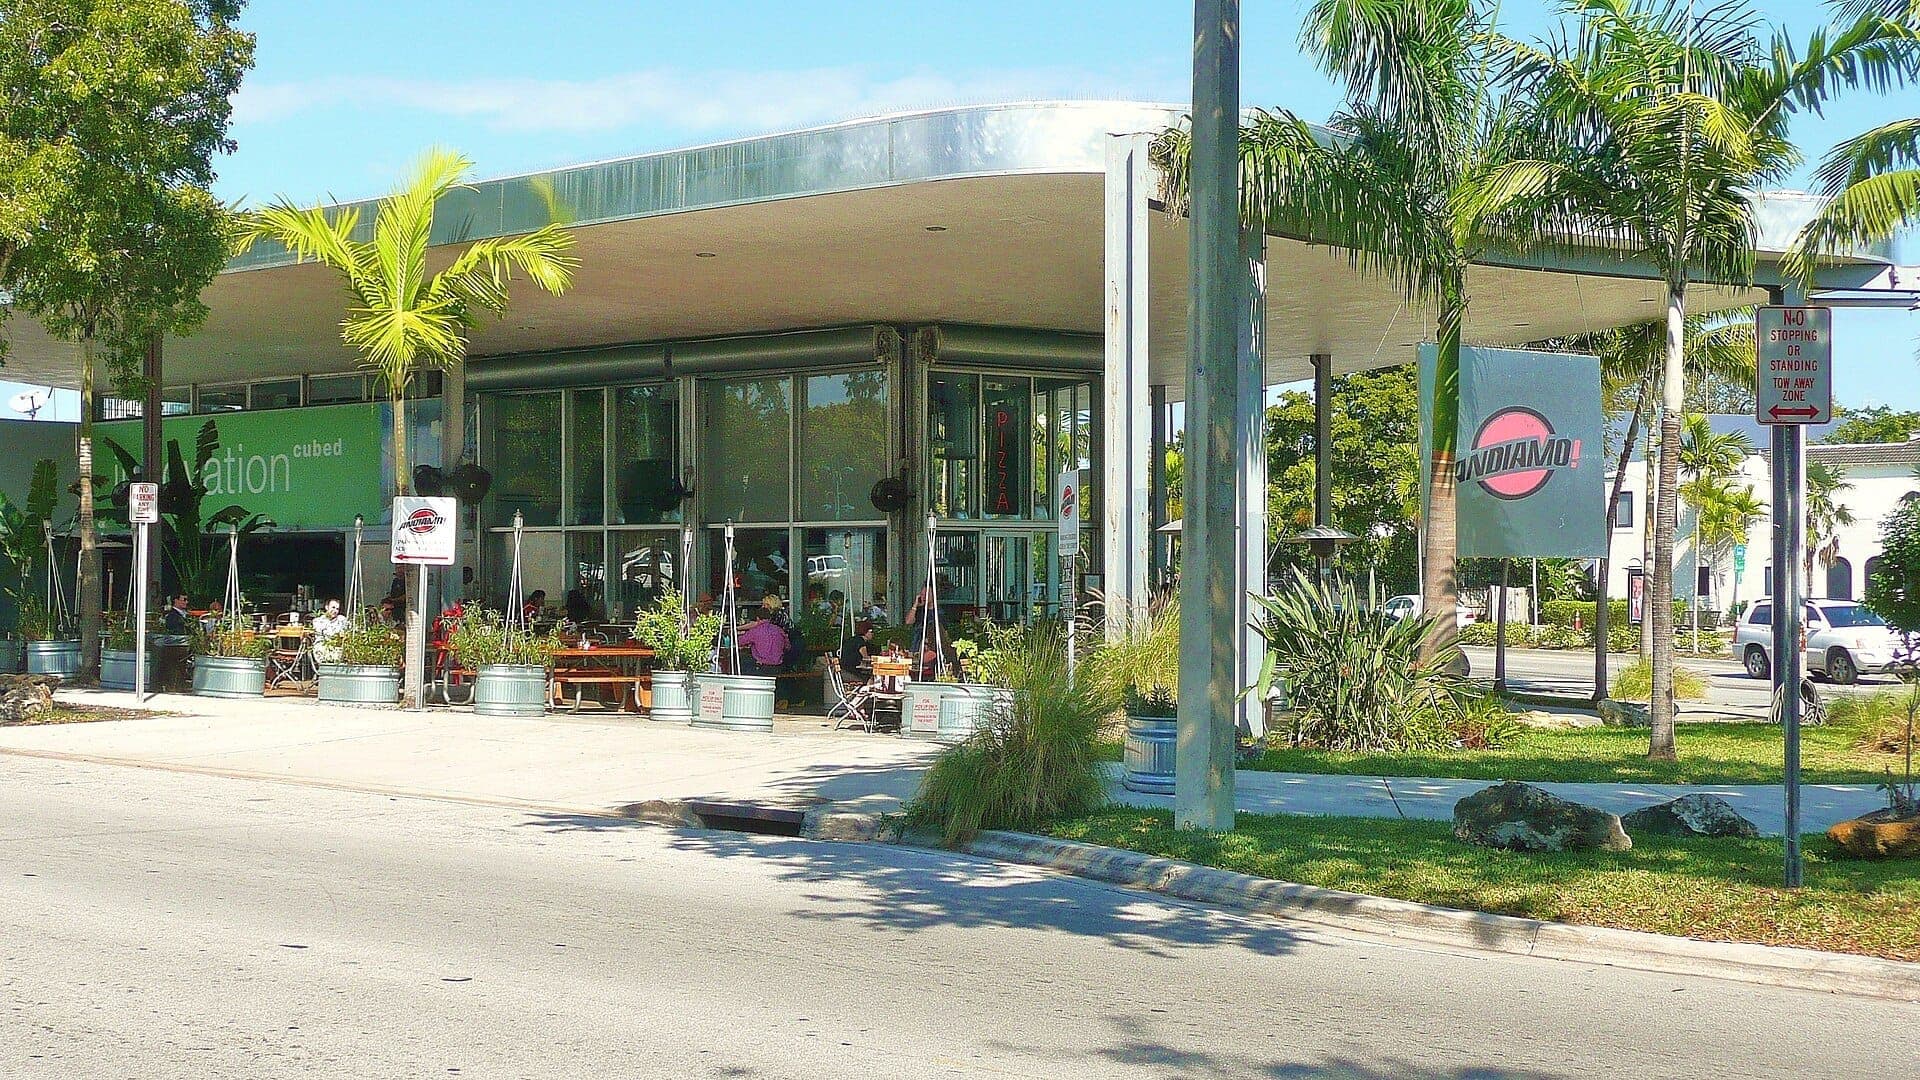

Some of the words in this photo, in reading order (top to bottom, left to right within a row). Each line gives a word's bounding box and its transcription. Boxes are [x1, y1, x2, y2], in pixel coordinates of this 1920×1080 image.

[1784, 310, 1804, 326] NO
[1770, 330, 1818, 341] STOPPING
[1787, 345, 1801, 356] OR
[1770, 360, 1818, 371] STANDING
[1773, 378, 1790, 389] TOW
[1794, 378, 1815, 389] AWAY
[1783, 390, 1806, 401] ZONE
[293, 438, 342, 458] cubed
[997, 411, 1009, 511] PIZZA
